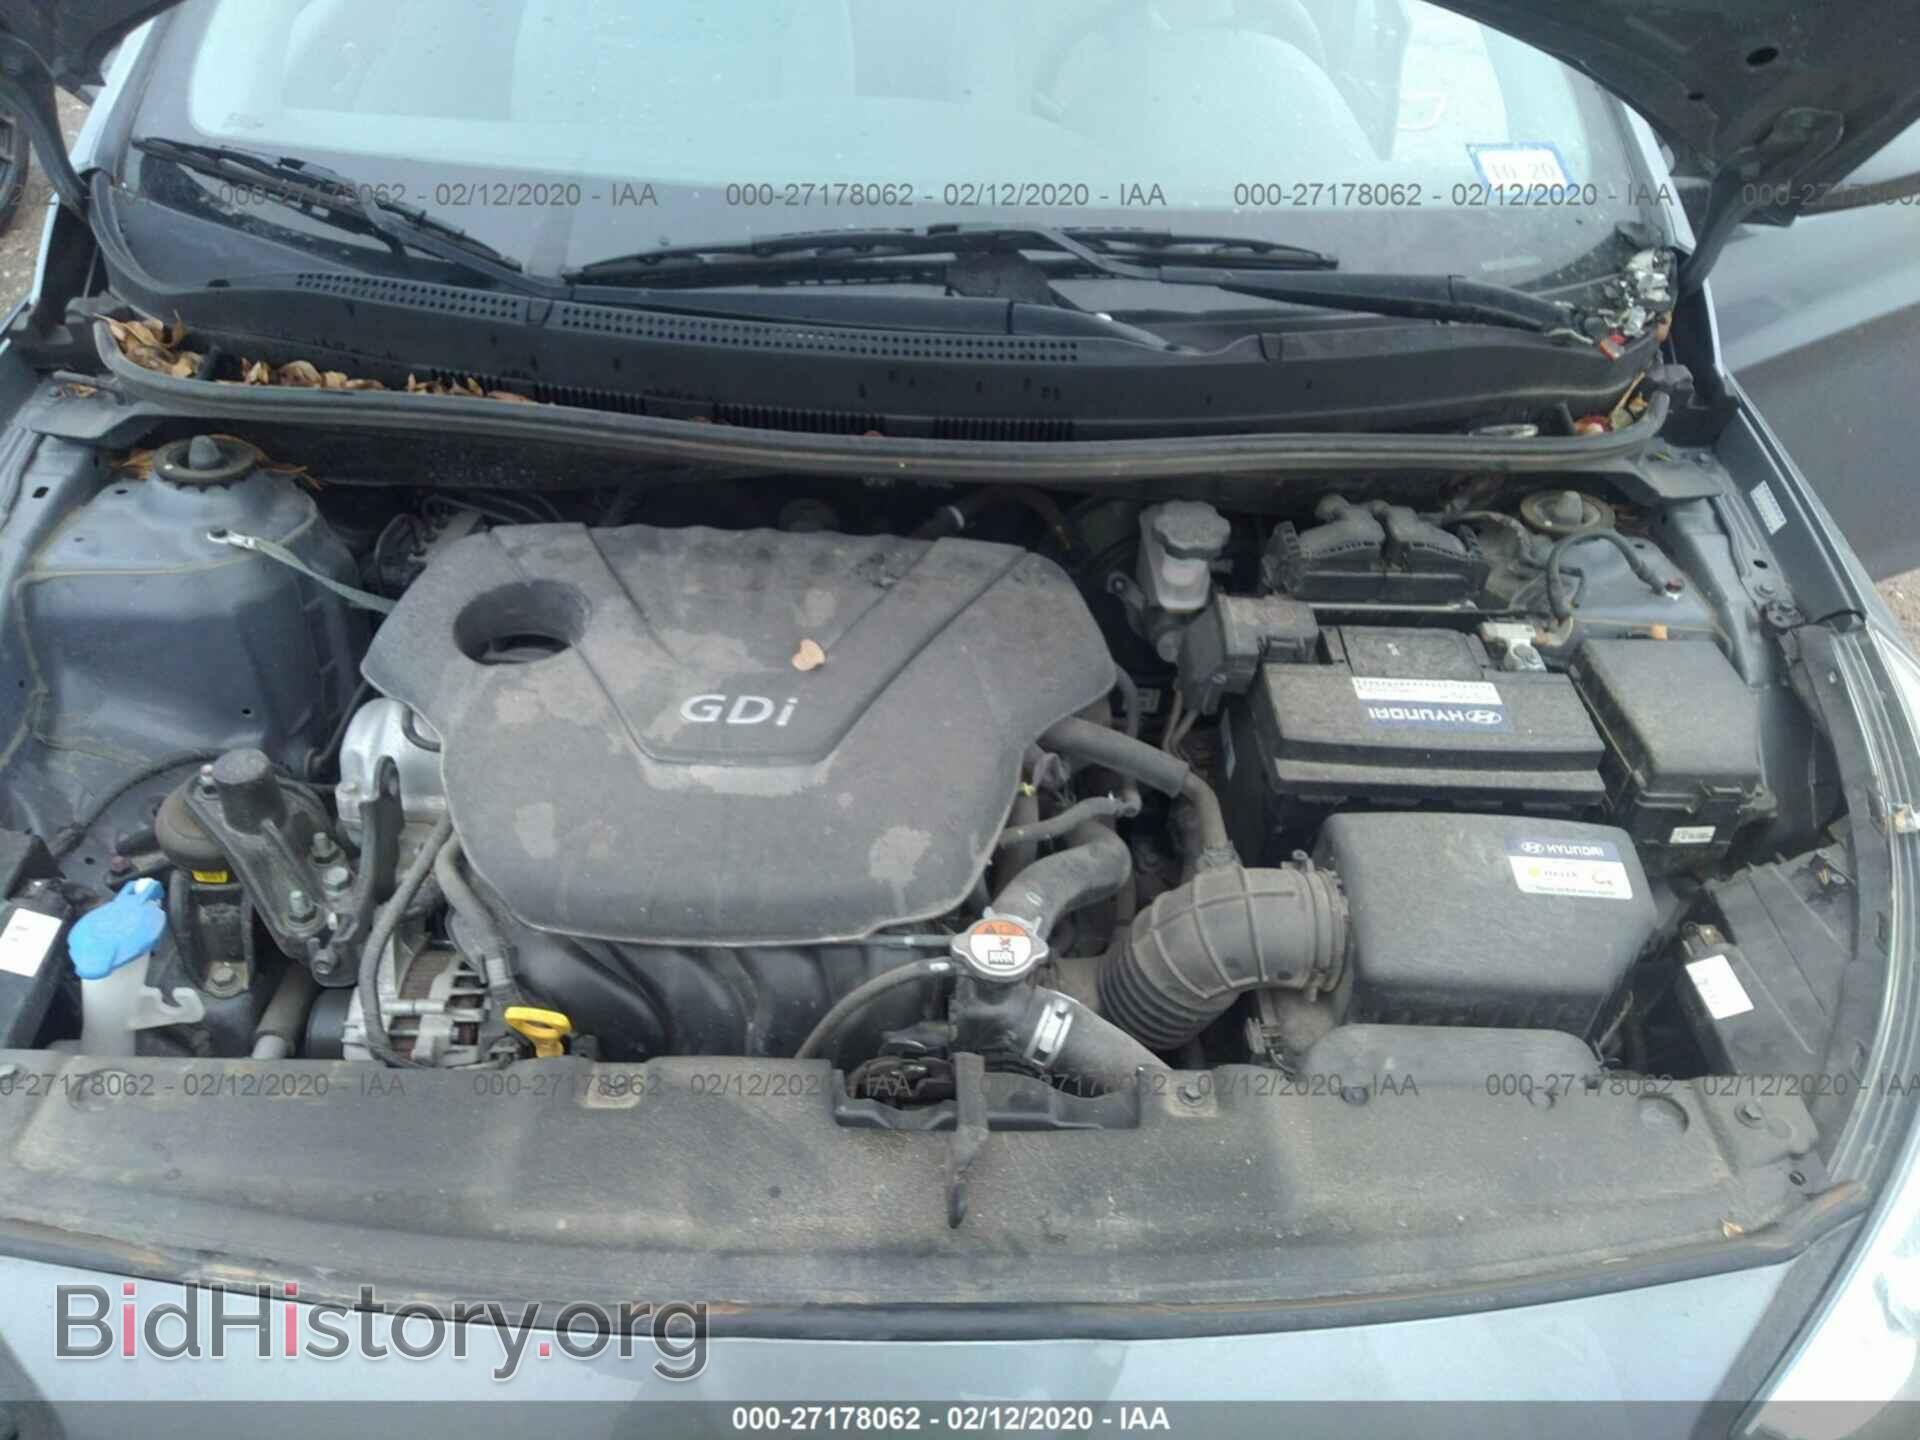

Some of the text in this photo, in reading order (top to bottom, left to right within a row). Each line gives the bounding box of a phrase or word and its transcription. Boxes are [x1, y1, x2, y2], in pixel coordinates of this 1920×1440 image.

[680, 694, 799, 727] GDi
[1368, 707, 1465, 722] HYUNDAI
[1546, 843, 1605, 857] HYUNDAI
